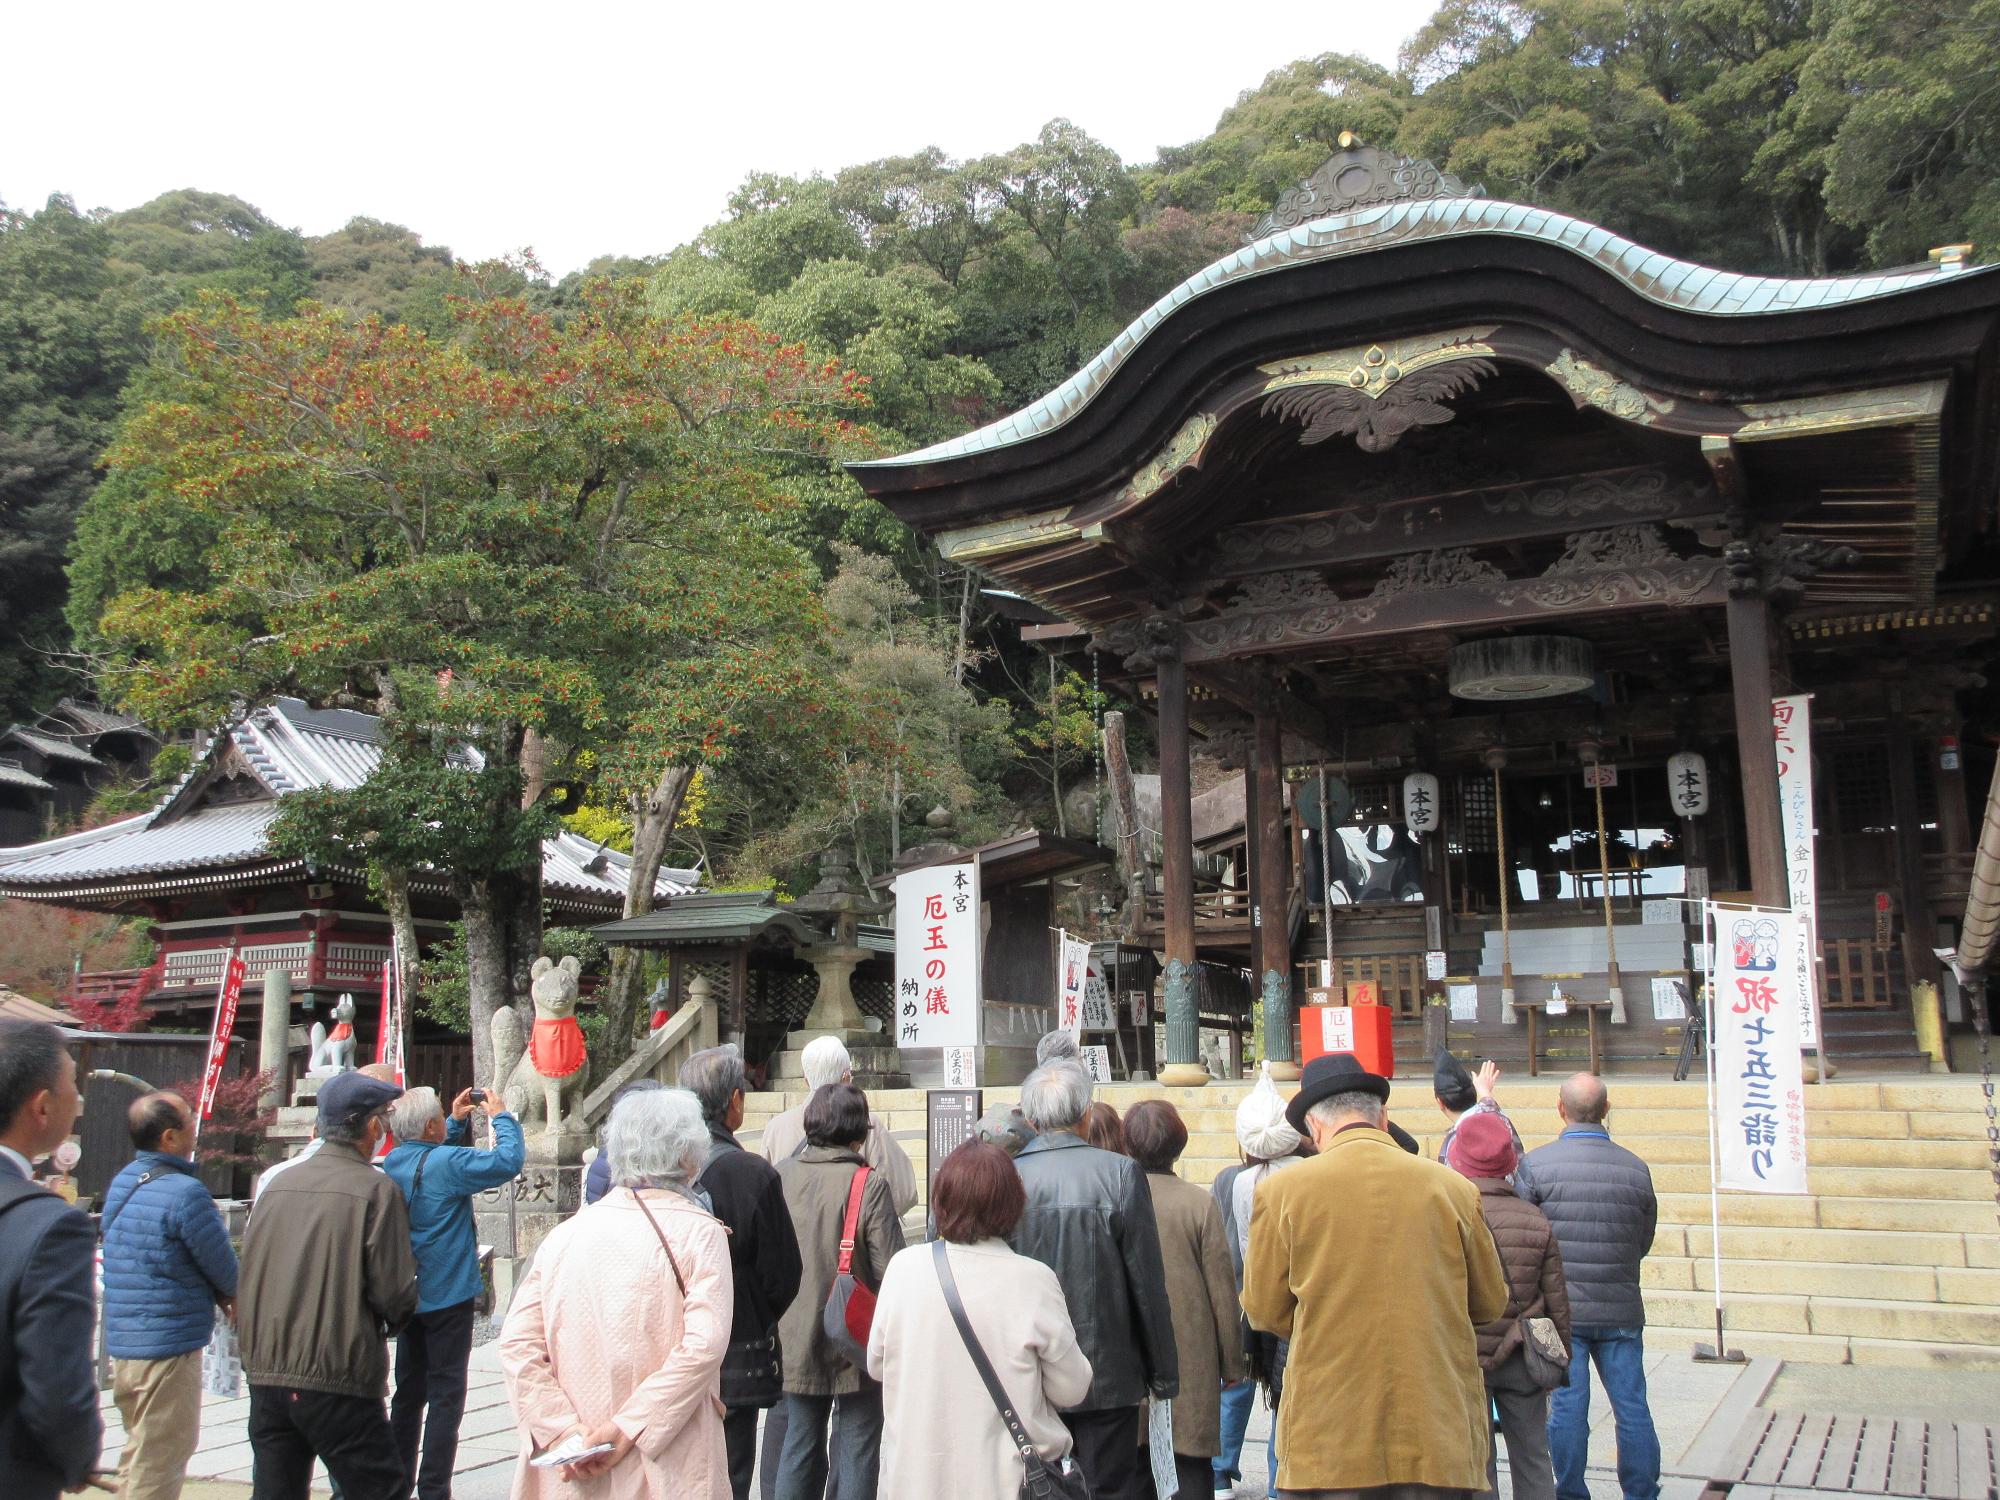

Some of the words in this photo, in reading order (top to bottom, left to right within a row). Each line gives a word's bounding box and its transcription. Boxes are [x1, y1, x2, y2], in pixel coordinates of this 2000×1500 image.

[1410, 787, 1432, 825] 本宮
[1677, 768, 1701, 809] 本宮
[952, 869, 970, 913] 本宮
[922, 894, 950, 1015] 厄玉の儀
[901, 977, 920, 1042] 納め所
[1353, 984, 1373, 1005] 厄
[1329, 1010, 1347, 1049] 厄玉
[950, 1048, 963, 1086] 厄玉の儀
